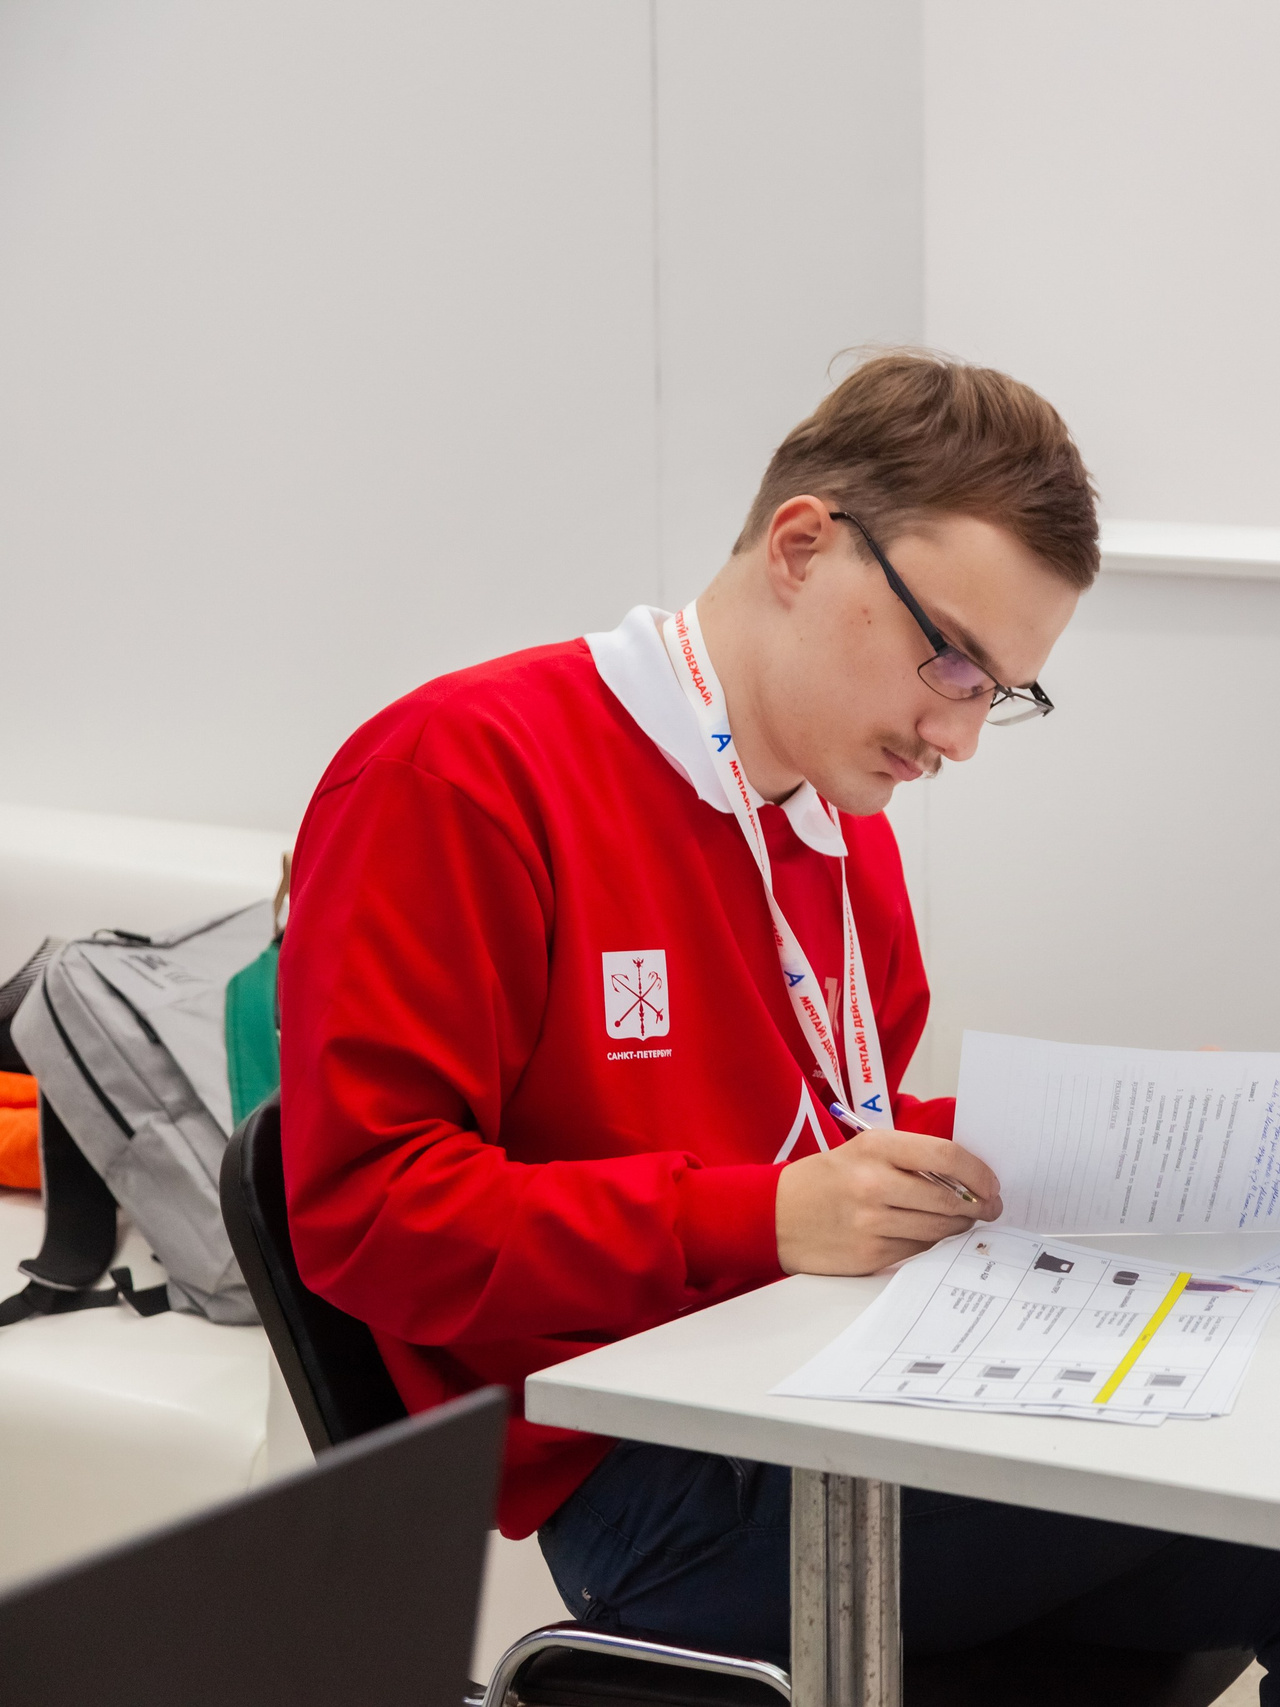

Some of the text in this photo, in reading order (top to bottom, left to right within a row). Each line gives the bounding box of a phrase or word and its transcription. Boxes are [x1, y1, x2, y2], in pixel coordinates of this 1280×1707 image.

[675, 609, 713, 706] СТВУЙ! ПОБЕЖДАЙ!
[729, 760, 752, 811] МЕЧТАЙ!
[799, 995, 828, 1040] МЕЧТАЙ!
[849, 963, 864, 1028] ДЕЙСТВУЙ!
[607, 1049, 672, 1060] САНКТ-ПЕТЕРБУРГ
[855, 1031, 873, 1083] МЕЧТАЙ!
